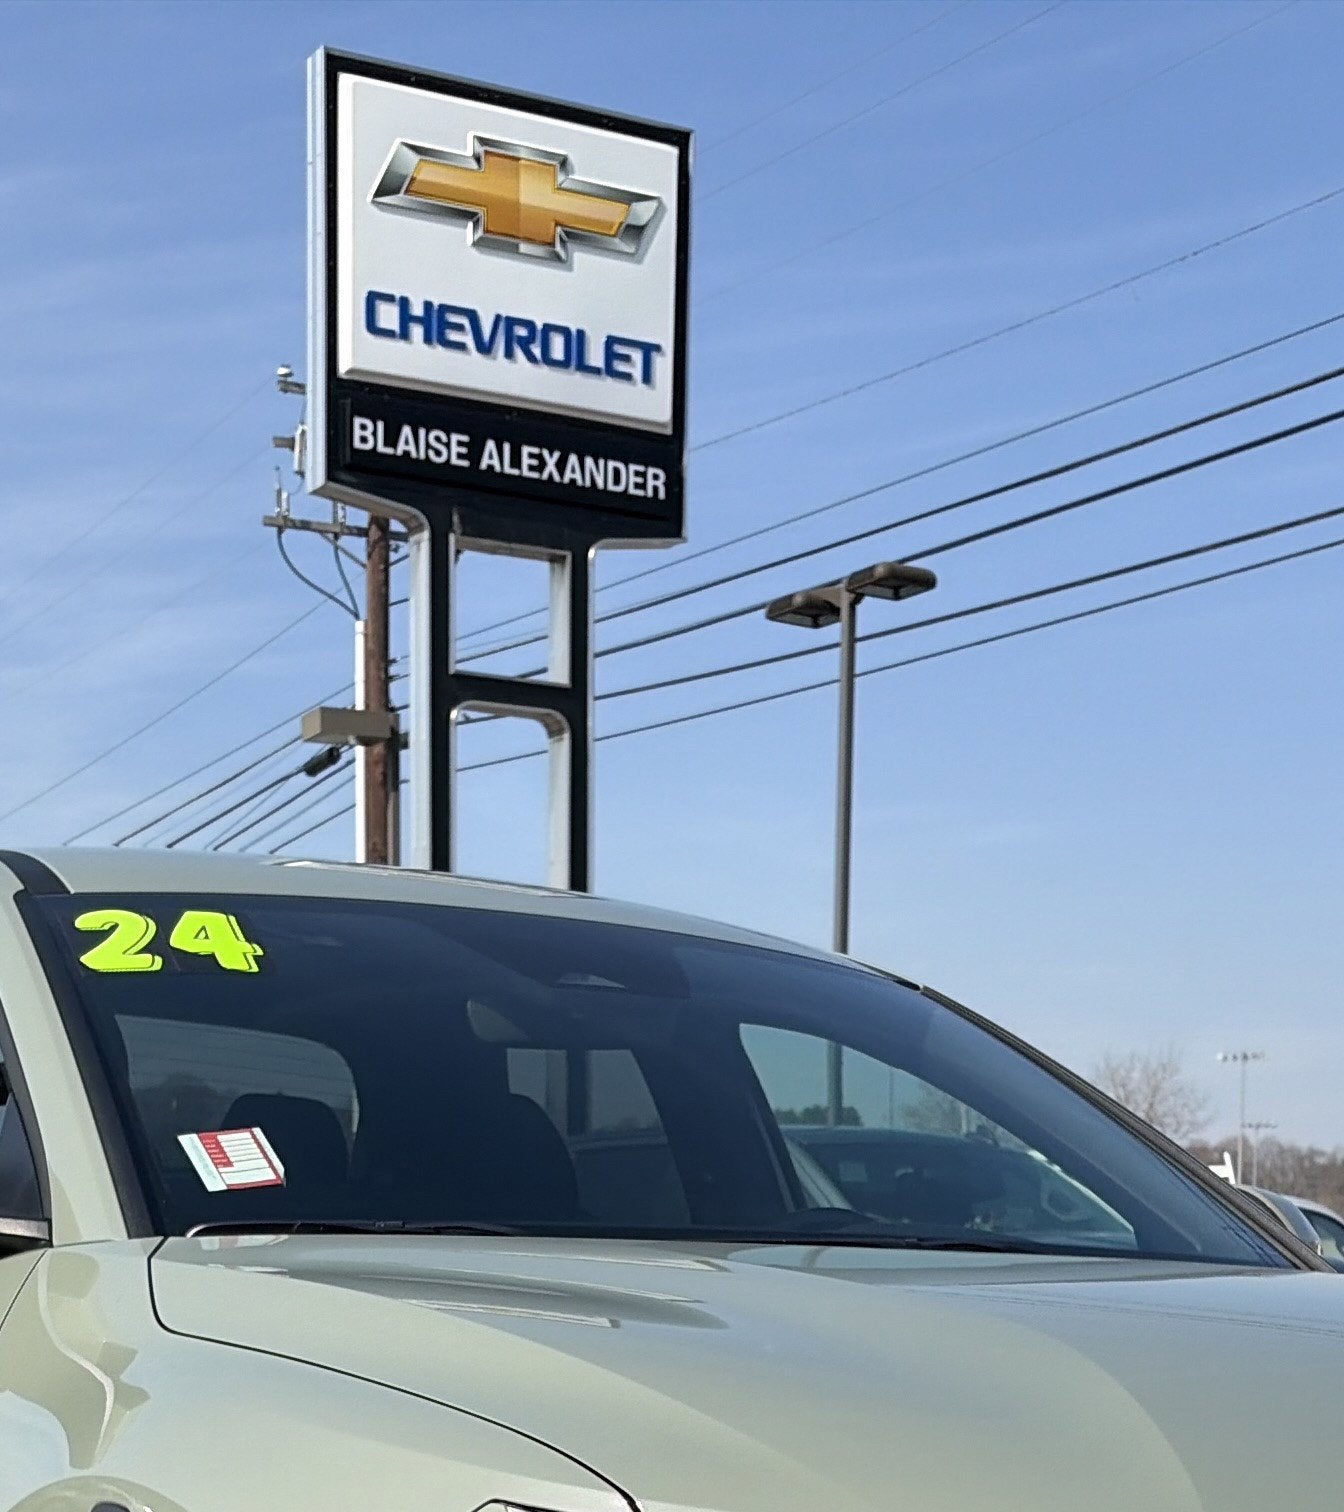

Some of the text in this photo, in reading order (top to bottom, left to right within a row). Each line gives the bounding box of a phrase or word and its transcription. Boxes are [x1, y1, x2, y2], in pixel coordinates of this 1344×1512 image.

[365, 289, 661, 386] CHEVROLET
[352, 416, 667, 500] BLAISE ALEXANDER
[74, 909, 264, 973] 24
